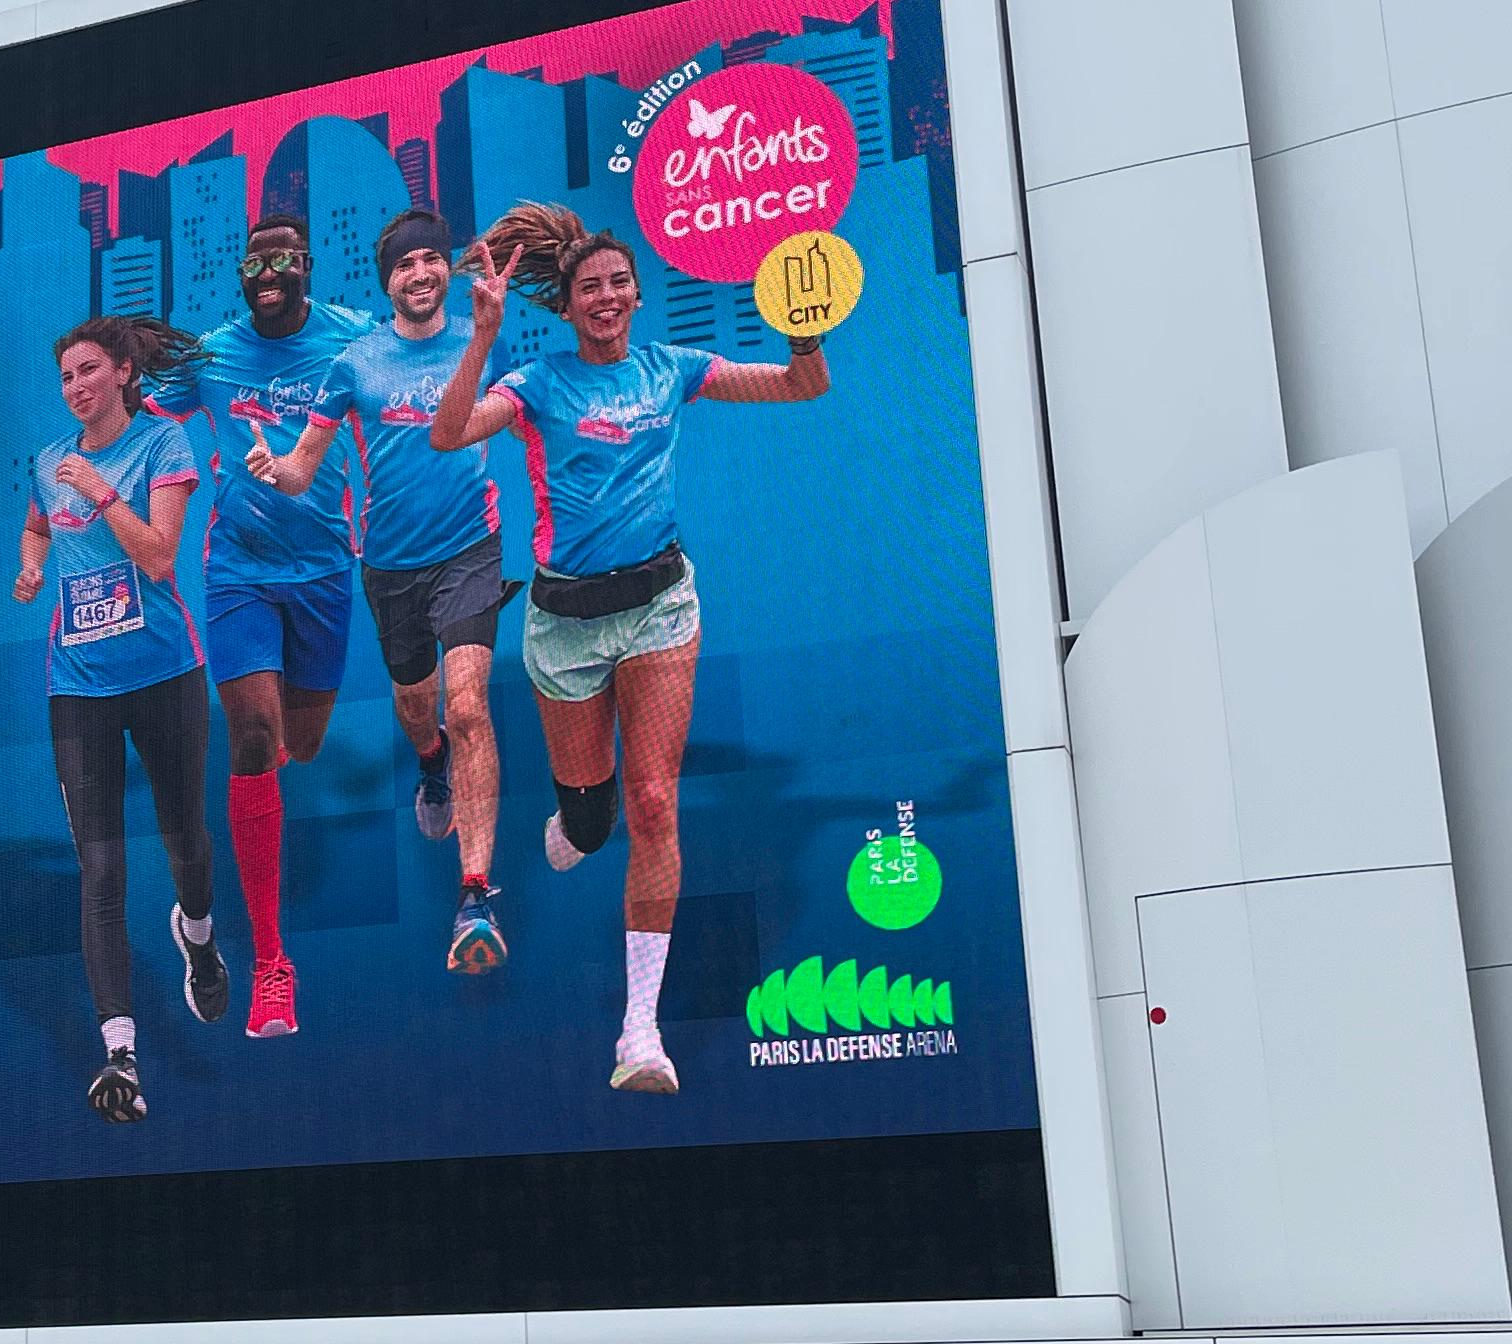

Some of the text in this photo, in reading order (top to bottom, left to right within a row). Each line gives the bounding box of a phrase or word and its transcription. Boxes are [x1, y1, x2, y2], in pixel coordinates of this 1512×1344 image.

[621, 59, 702, 138] édition
[663, 111, 830, 188] enfants
[663, 179, 832, 238] cancer
[666, 185, 712, 206] SANS
[788, 303, 833, 325] CITY
[75, 599, 117, 626] 1467
[866, 828, 885, 885] PARIS
[896, 800, 919, 883] DEFENSE
[886, 858, 902, 884] LA
[750, 1029, 958, 1067] PARIS LA DEFENSE ARENA
